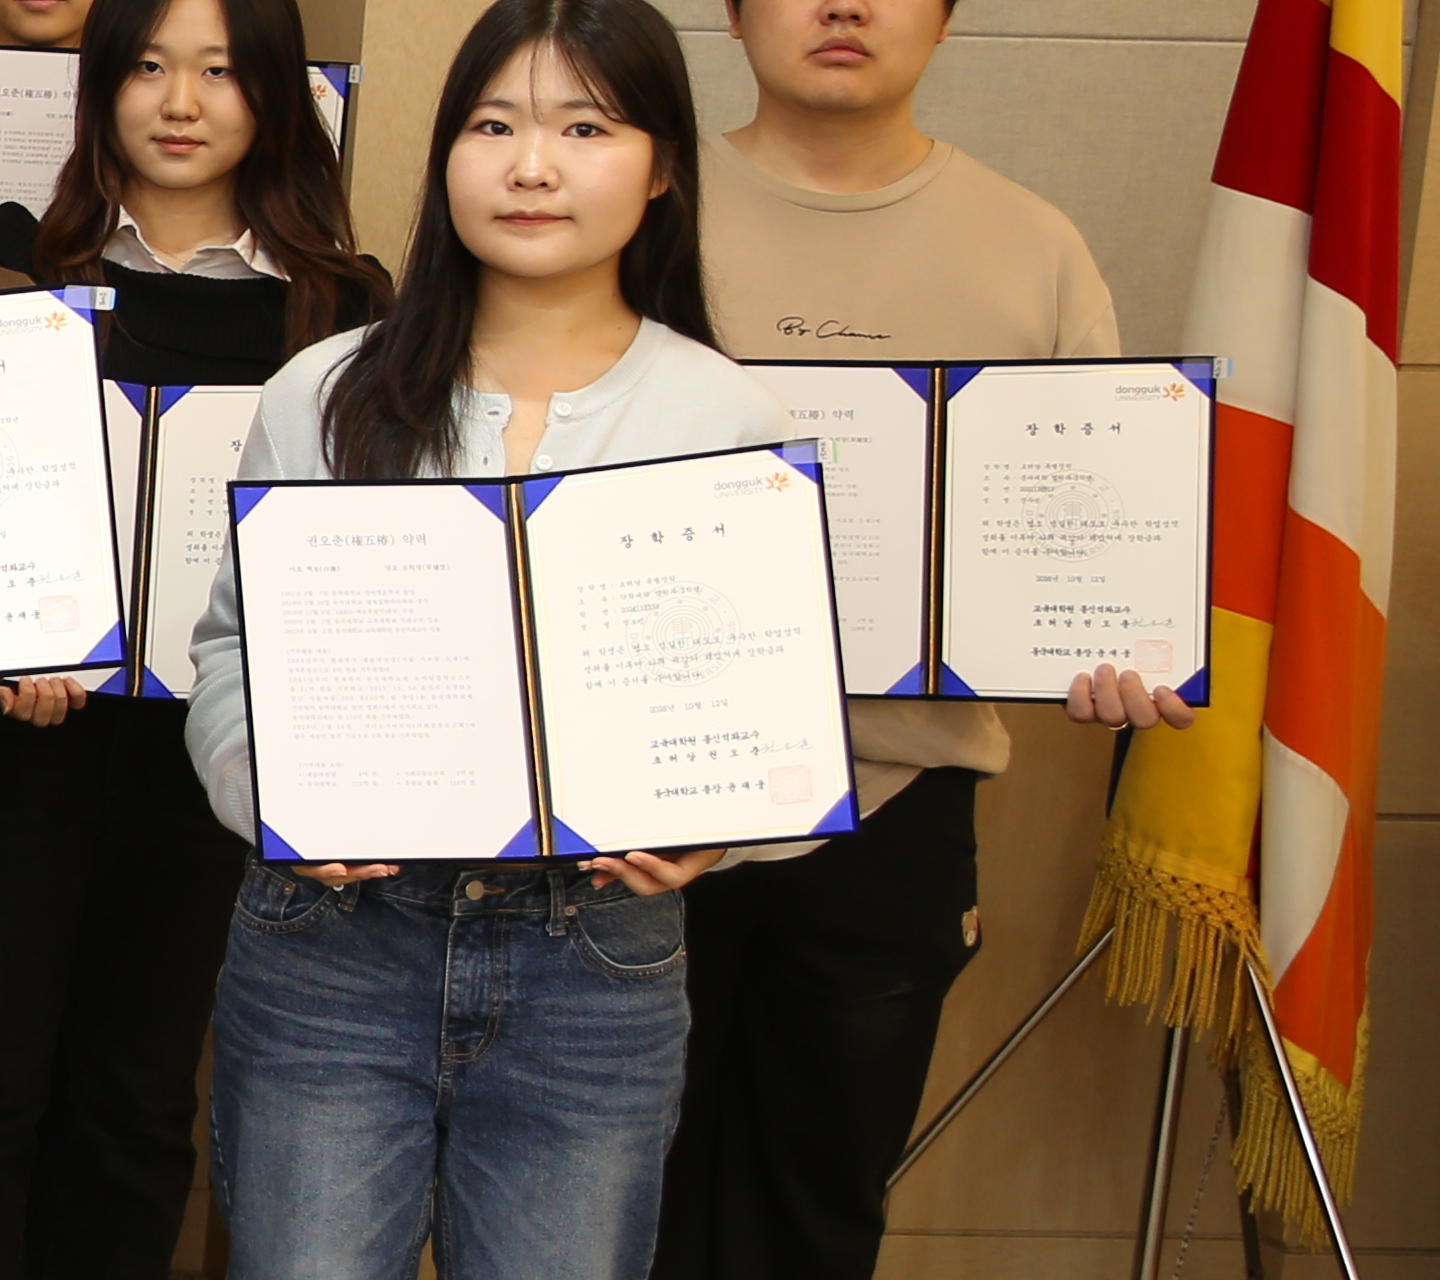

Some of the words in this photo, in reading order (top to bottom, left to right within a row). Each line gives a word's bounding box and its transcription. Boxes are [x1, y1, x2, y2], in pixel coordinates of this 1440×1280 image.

[1115, 385, 1160, 396] dongguk
[1025, 423, 1039, 436] 장
[1054, 423, 1066, 435] 학
[1081, 422, 1094, 435] 증
[1109, 422, 1121, 435] 서
[714, 478, 763, 492] dongguk
[620, 534, 634, 549] 장
[651, 531, 664, 544] 학
[681, 527, 695, 541] 증
[713, 523, 724, 537] 서
